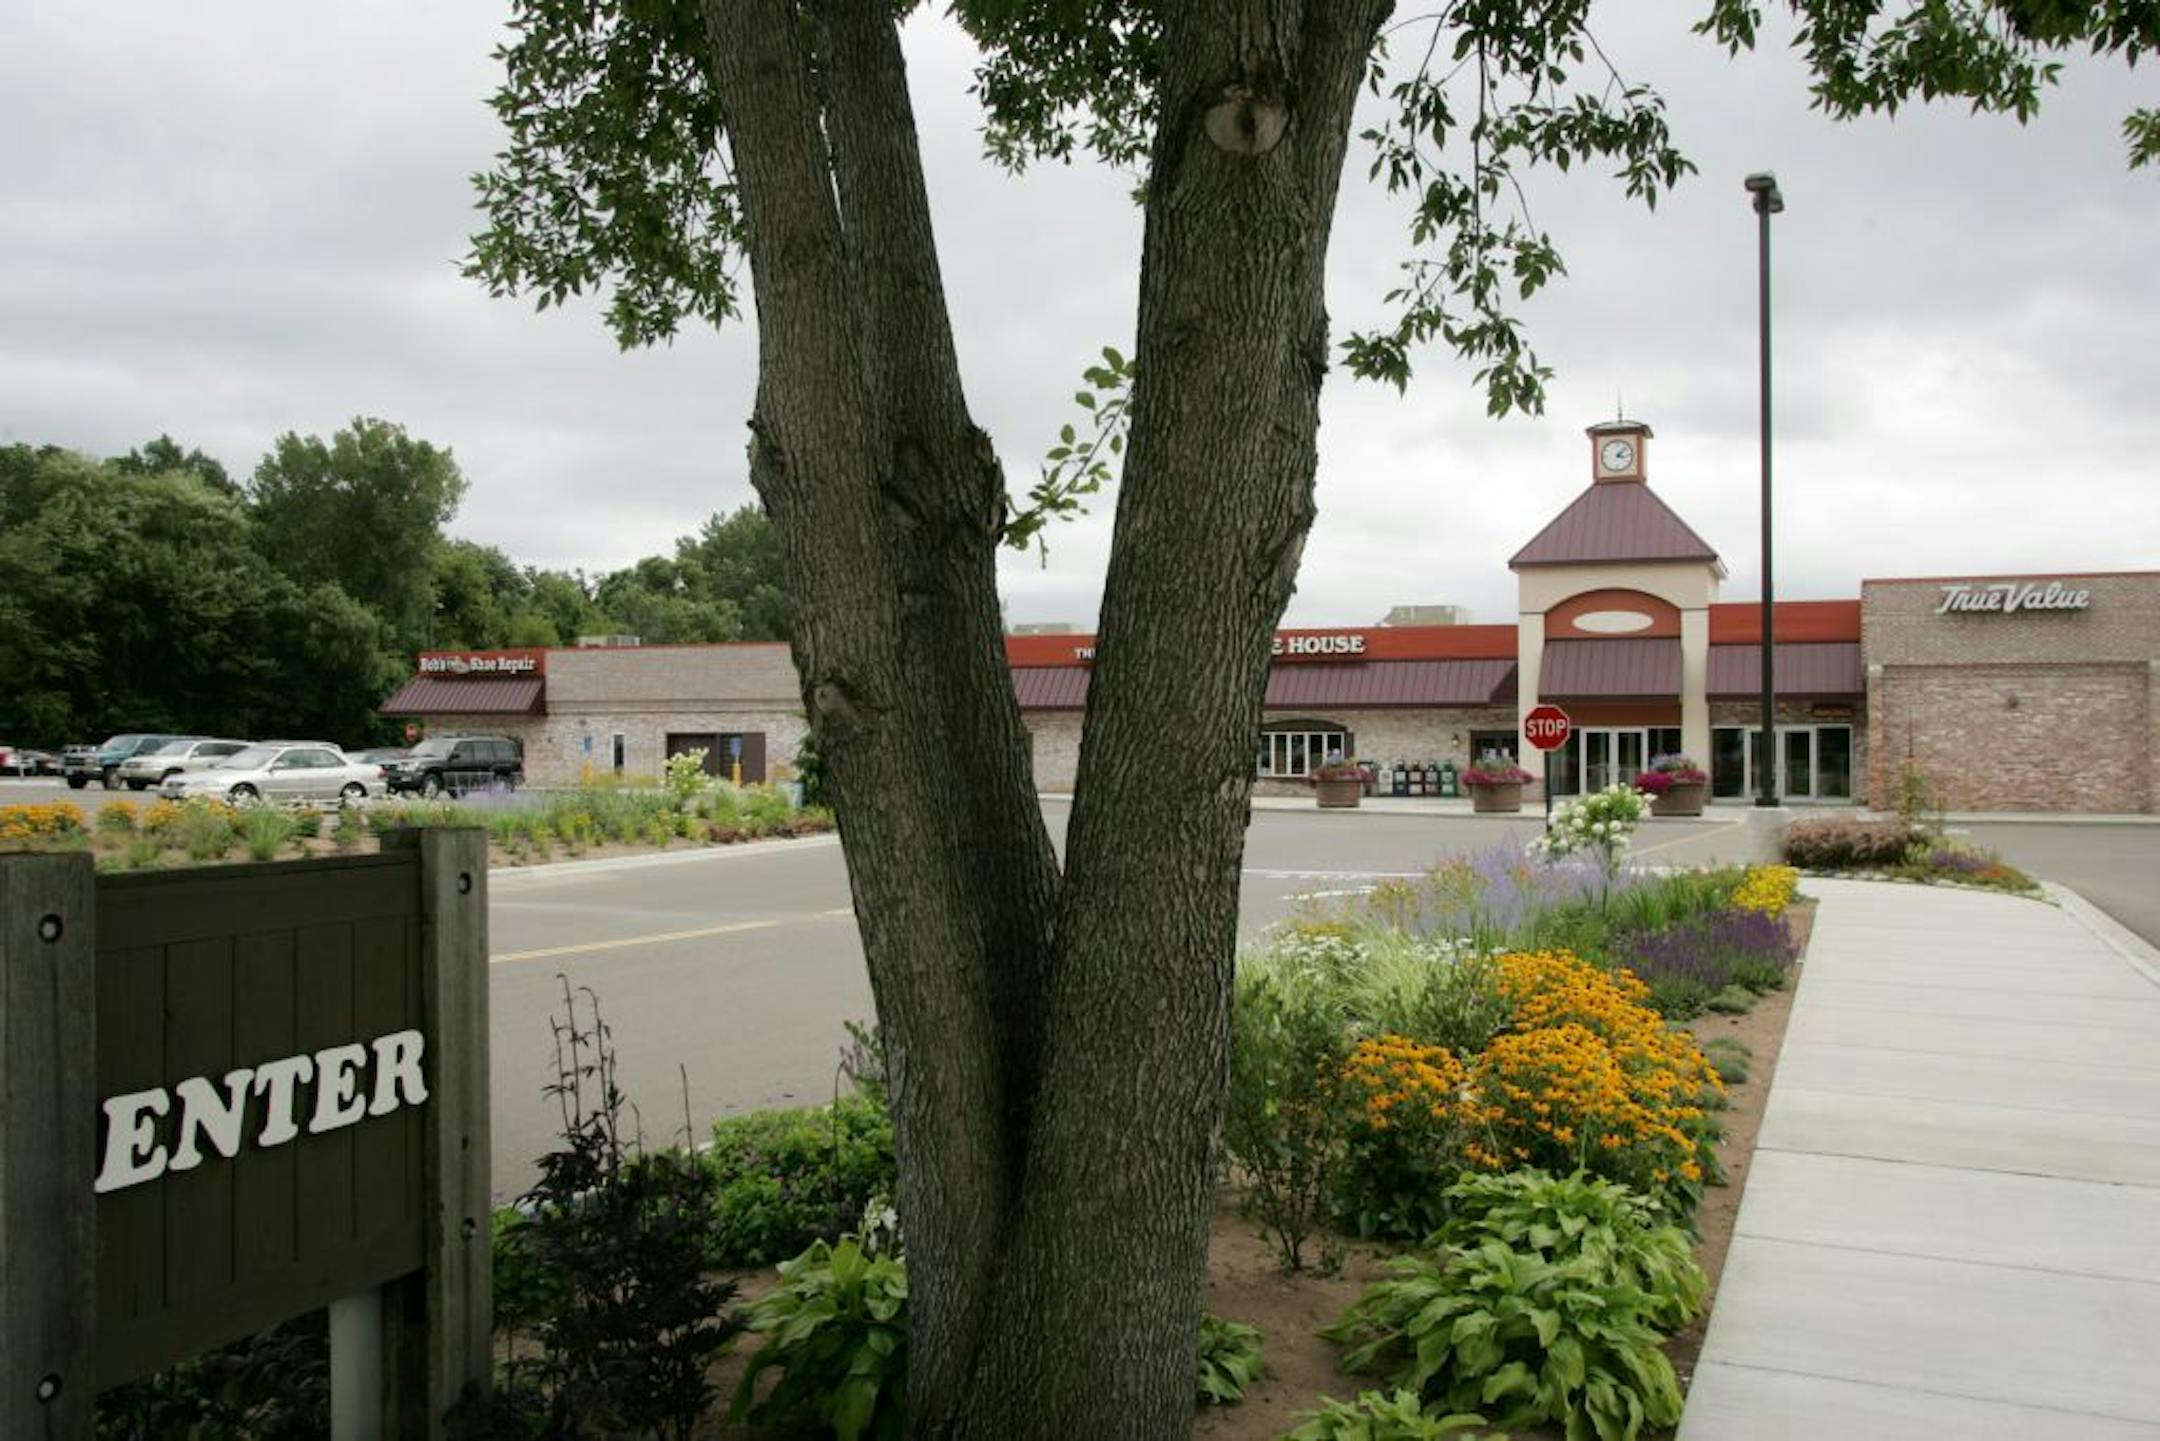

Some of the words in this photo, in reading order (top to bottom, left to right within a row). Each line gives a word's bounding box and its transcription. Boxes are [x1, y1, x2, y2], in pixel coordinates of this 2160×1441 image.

[1288, 634, 1365, 654] HOUSE
[470, 656, 497, 672] Shoe
[498, 655, 535, 674] Repair
[1526, 718, 1567, 737] STOP
[94, 1029, 429, 1193] ENTER
